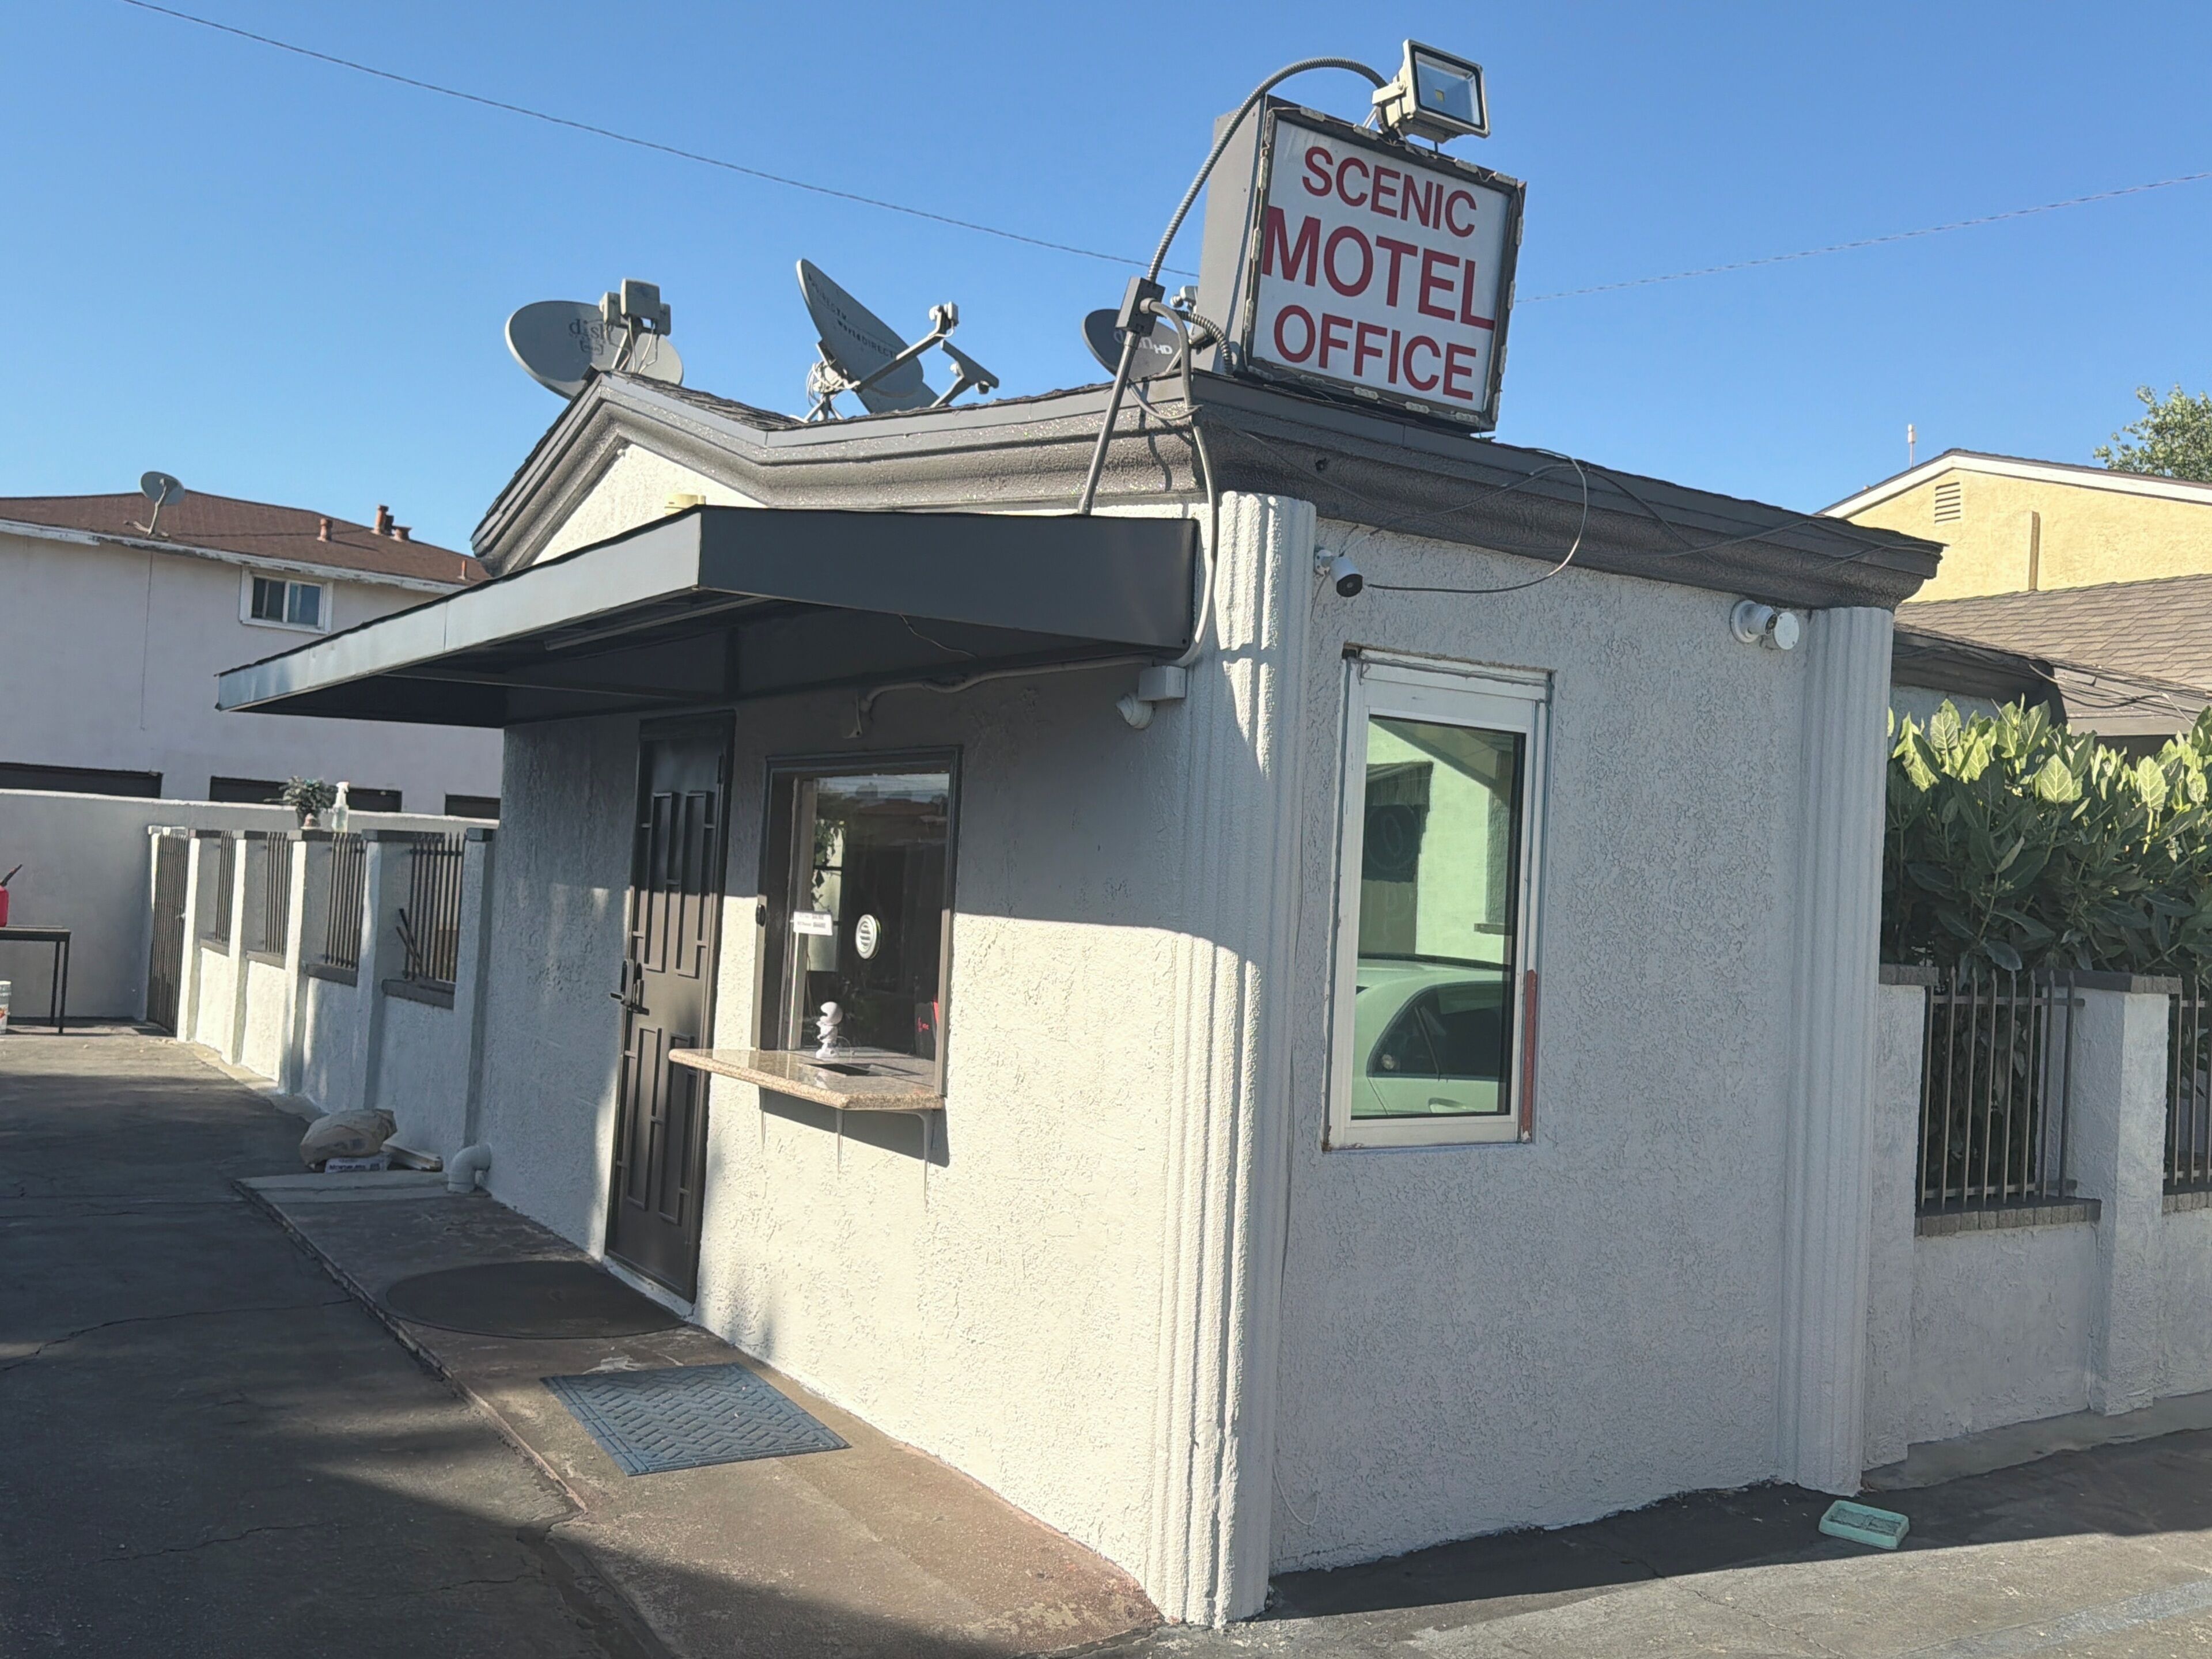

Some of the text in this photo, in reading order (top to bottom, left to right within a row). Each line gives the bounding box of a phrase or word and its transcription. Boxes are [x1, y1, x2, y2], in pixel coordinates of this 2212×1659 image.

[1302, 146, 1477, 237] SCENIC
[1262, 204, 1495, 330] MOTEL
[1153, 344, 1173, 354] HD
[1274, 305, 1476, 400] OFFICE
